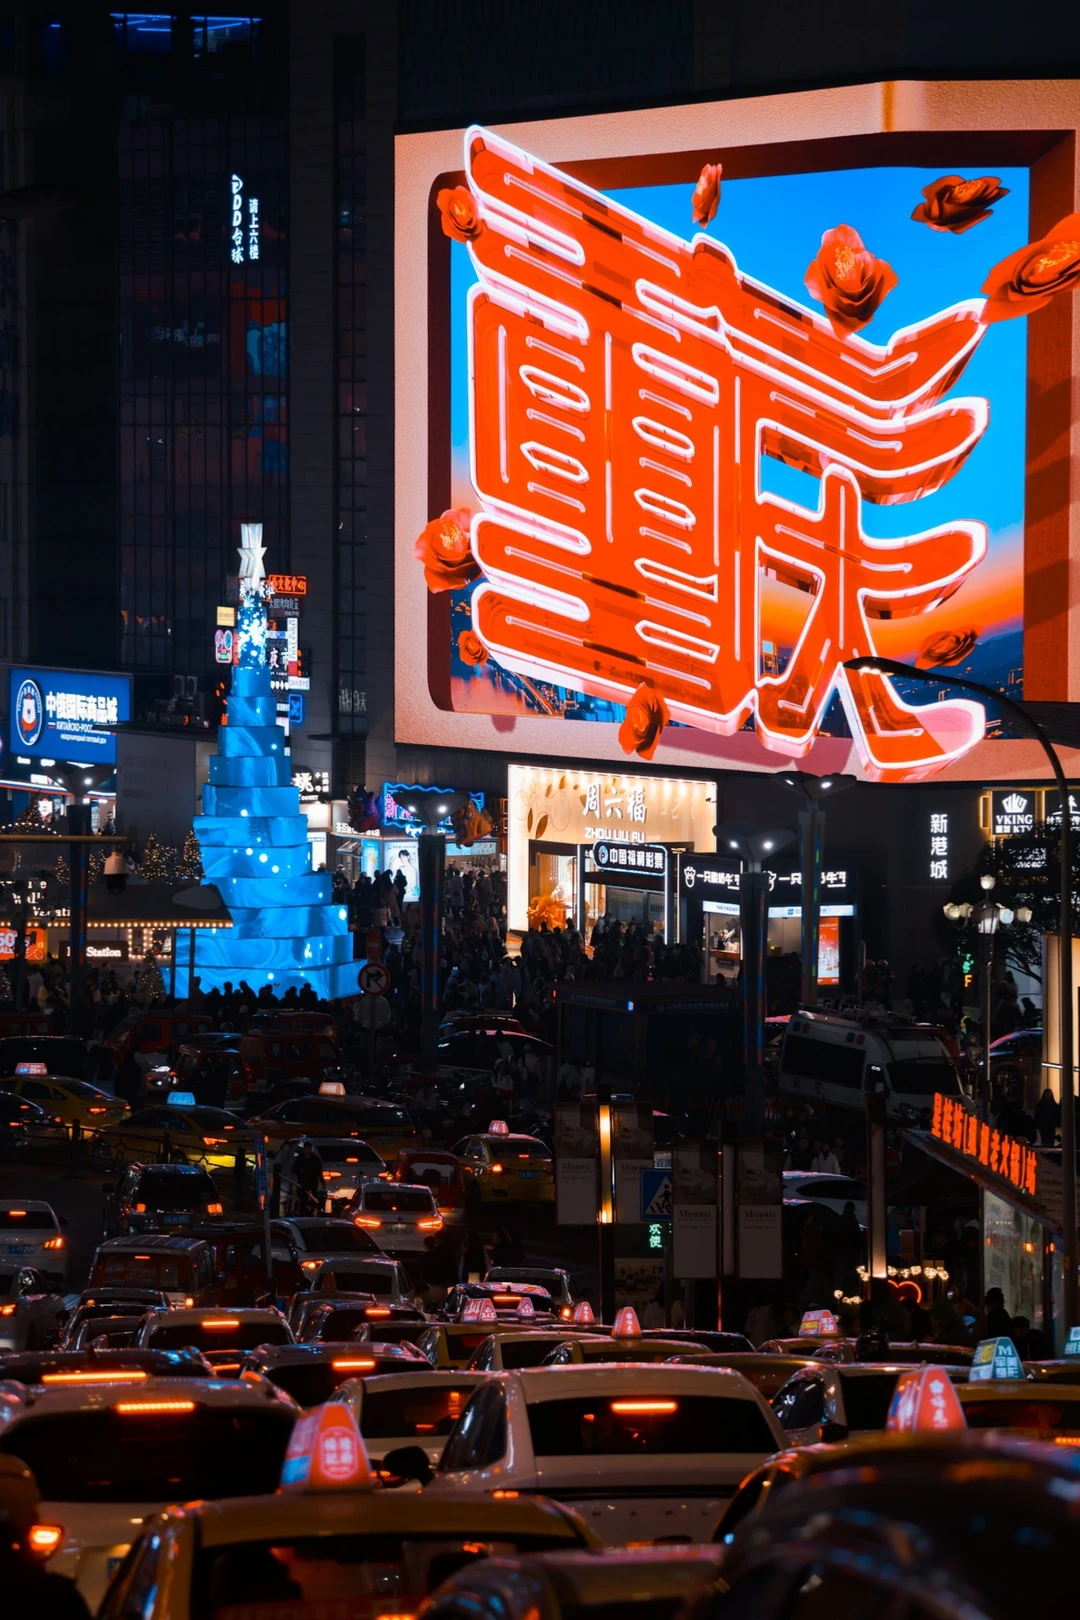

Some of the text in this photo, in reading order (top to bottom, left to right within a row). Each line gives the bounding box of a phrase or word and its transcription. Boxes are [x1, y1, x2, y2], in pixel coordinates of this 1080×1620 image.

[249, 198, 259, 260] 请上六楼
[583, 784, 647, 823] 周六福
[996, 814, 1033, 825] VKING
[584, 827, 612, 841] ZHOU
[632, 832, 646, 843] FU
[1013, 825, 1033, 834] KTV
[930, 814, 948, 879] 新港城
[609, 848, 664, 869] 中国福利彩票
[86, 946, 121, 957] Station
[679, 1209, 711, 1218] Minotti
[744, 1210, 776, 1219] Minotti
